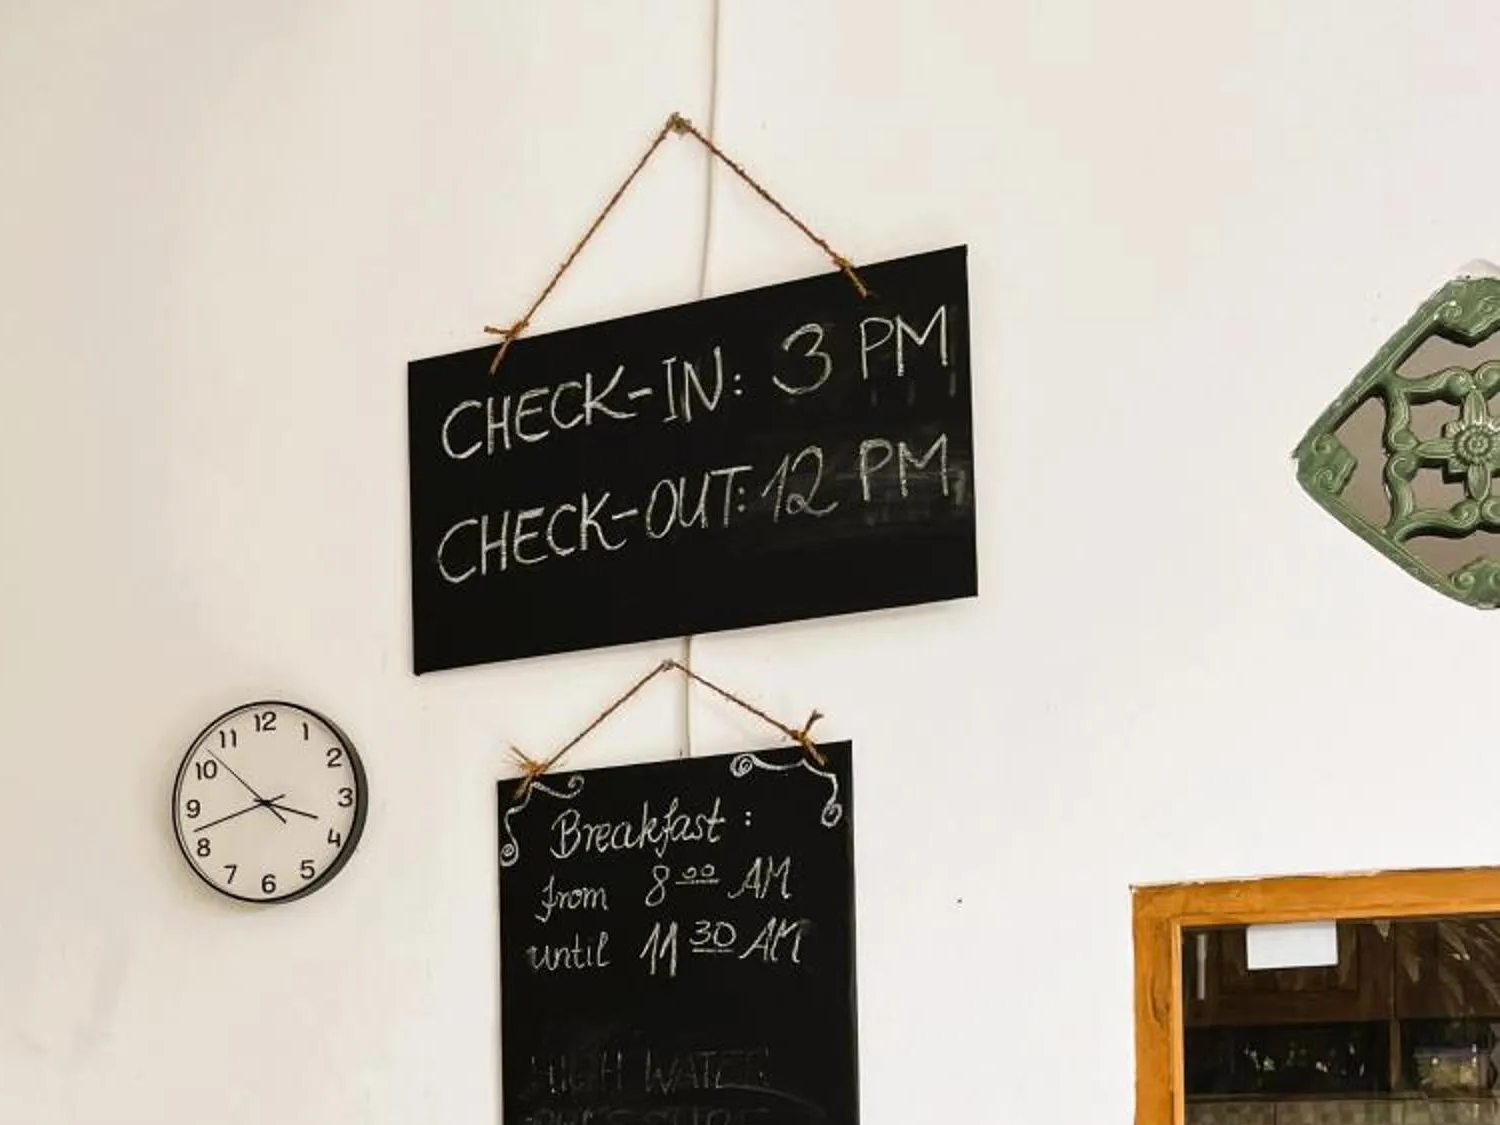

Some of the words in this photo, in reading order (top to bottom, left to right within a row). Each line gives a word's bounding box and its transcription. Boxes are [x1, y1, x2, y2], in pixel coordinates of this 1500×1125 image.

[441, 346, 743, 459] CHECK-IN:
[772, 322, 833, 394] 3
[859, 305, 949, 380] PM
[437, 464, 752, 583] CHECK-OUT:
[761, 445, 838, 523] 12
[859, 433, 949, 501] PM
[254, 711, 277, 732] 12
[302, 721, 309, 741] 1
[219, 729, 237, 748] 11
[326, 747, 343, 768] 2
[195, 759, 217, 780] 10
[337, 787, 353, 808] 3
[185, 799, 200, 818] 9
[197, 837, 211, 857] 8
[327, 828, 342, 848] 4
[223, 864, 237, 884] 7
[300, 860, 316, 880] 5
[261, 874, 276, 893] 6
[535, 875, 609, 922] from
[728, 856, 793, 899] AM
[529, 931, 610, 971] until
[740, 917, 803, 963] AM
